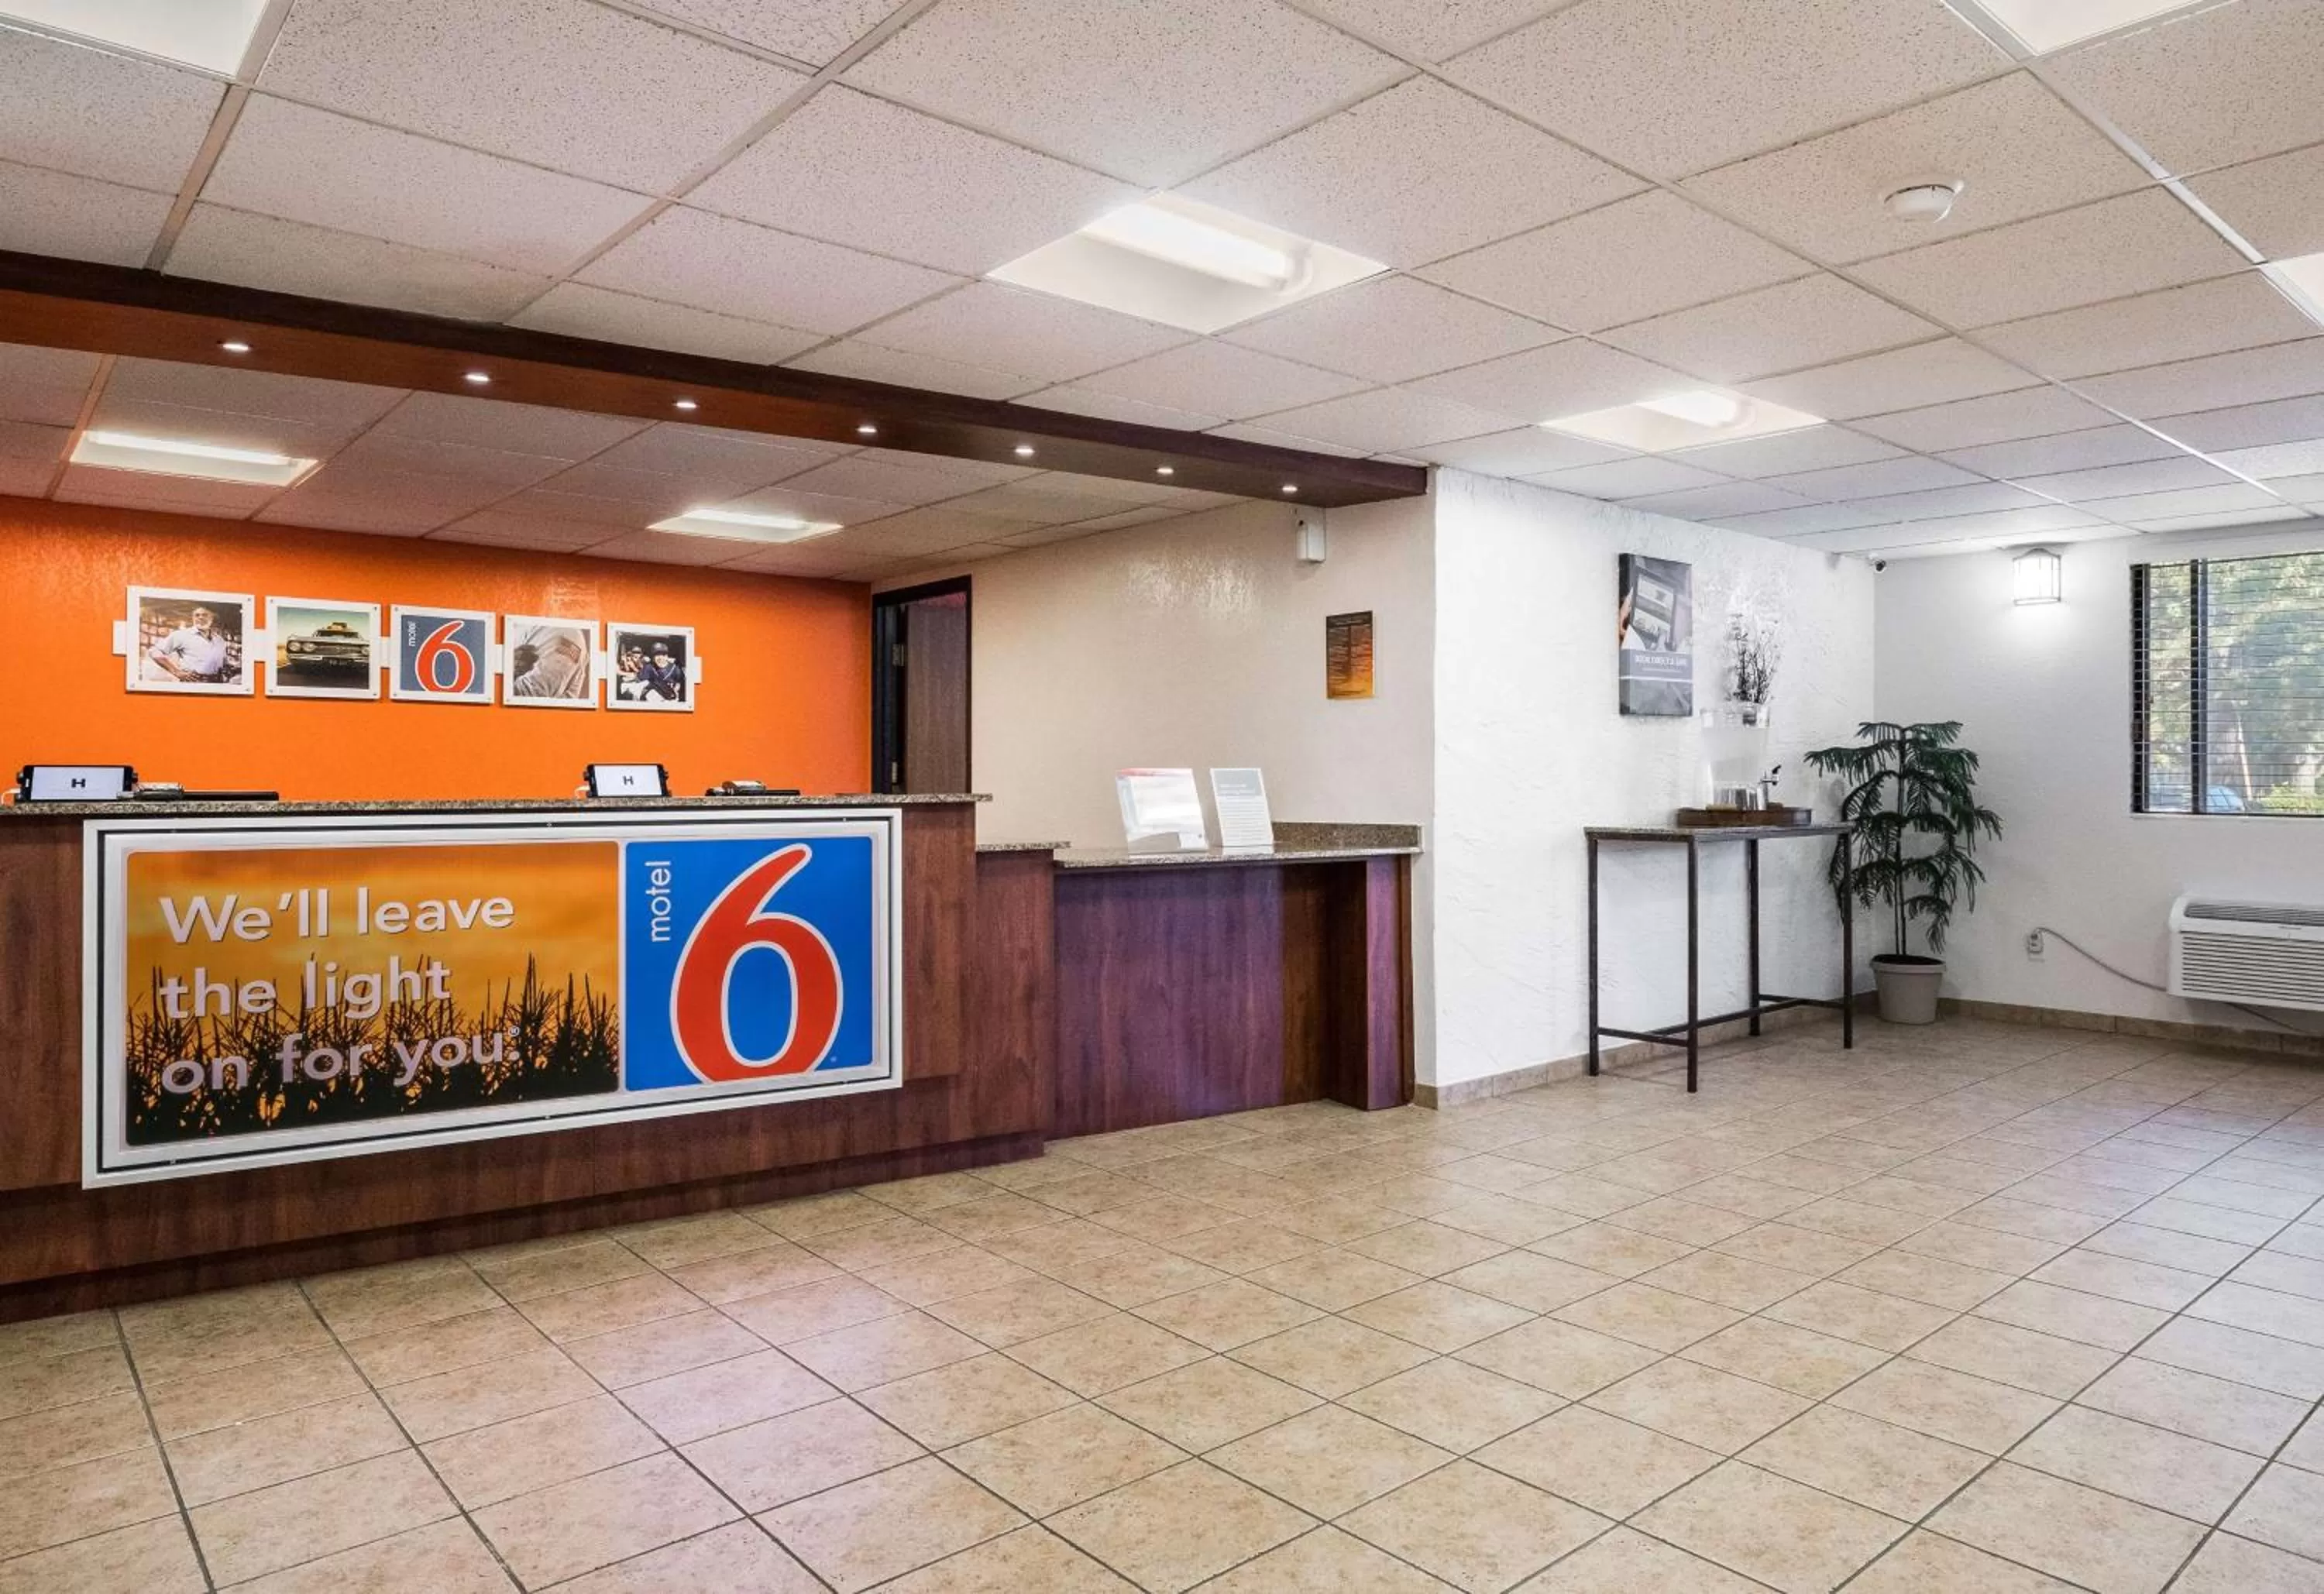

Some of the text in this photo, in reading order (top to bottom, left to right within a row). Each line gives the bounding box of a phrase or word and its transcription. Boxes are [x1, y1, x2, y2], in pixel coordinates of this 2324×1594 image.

[414, 620, 475, 694] 6
[623, 775, 634, 785] H
[159, 886, 515, 944] We'll leave
[645, 861, 672, 942] motel
[159, 955, 451, 1020] the light
[669, 843, 844, 1084] 6
[161, 1054, 249, 1094] on
[275, 1032, 373, 1084] for
